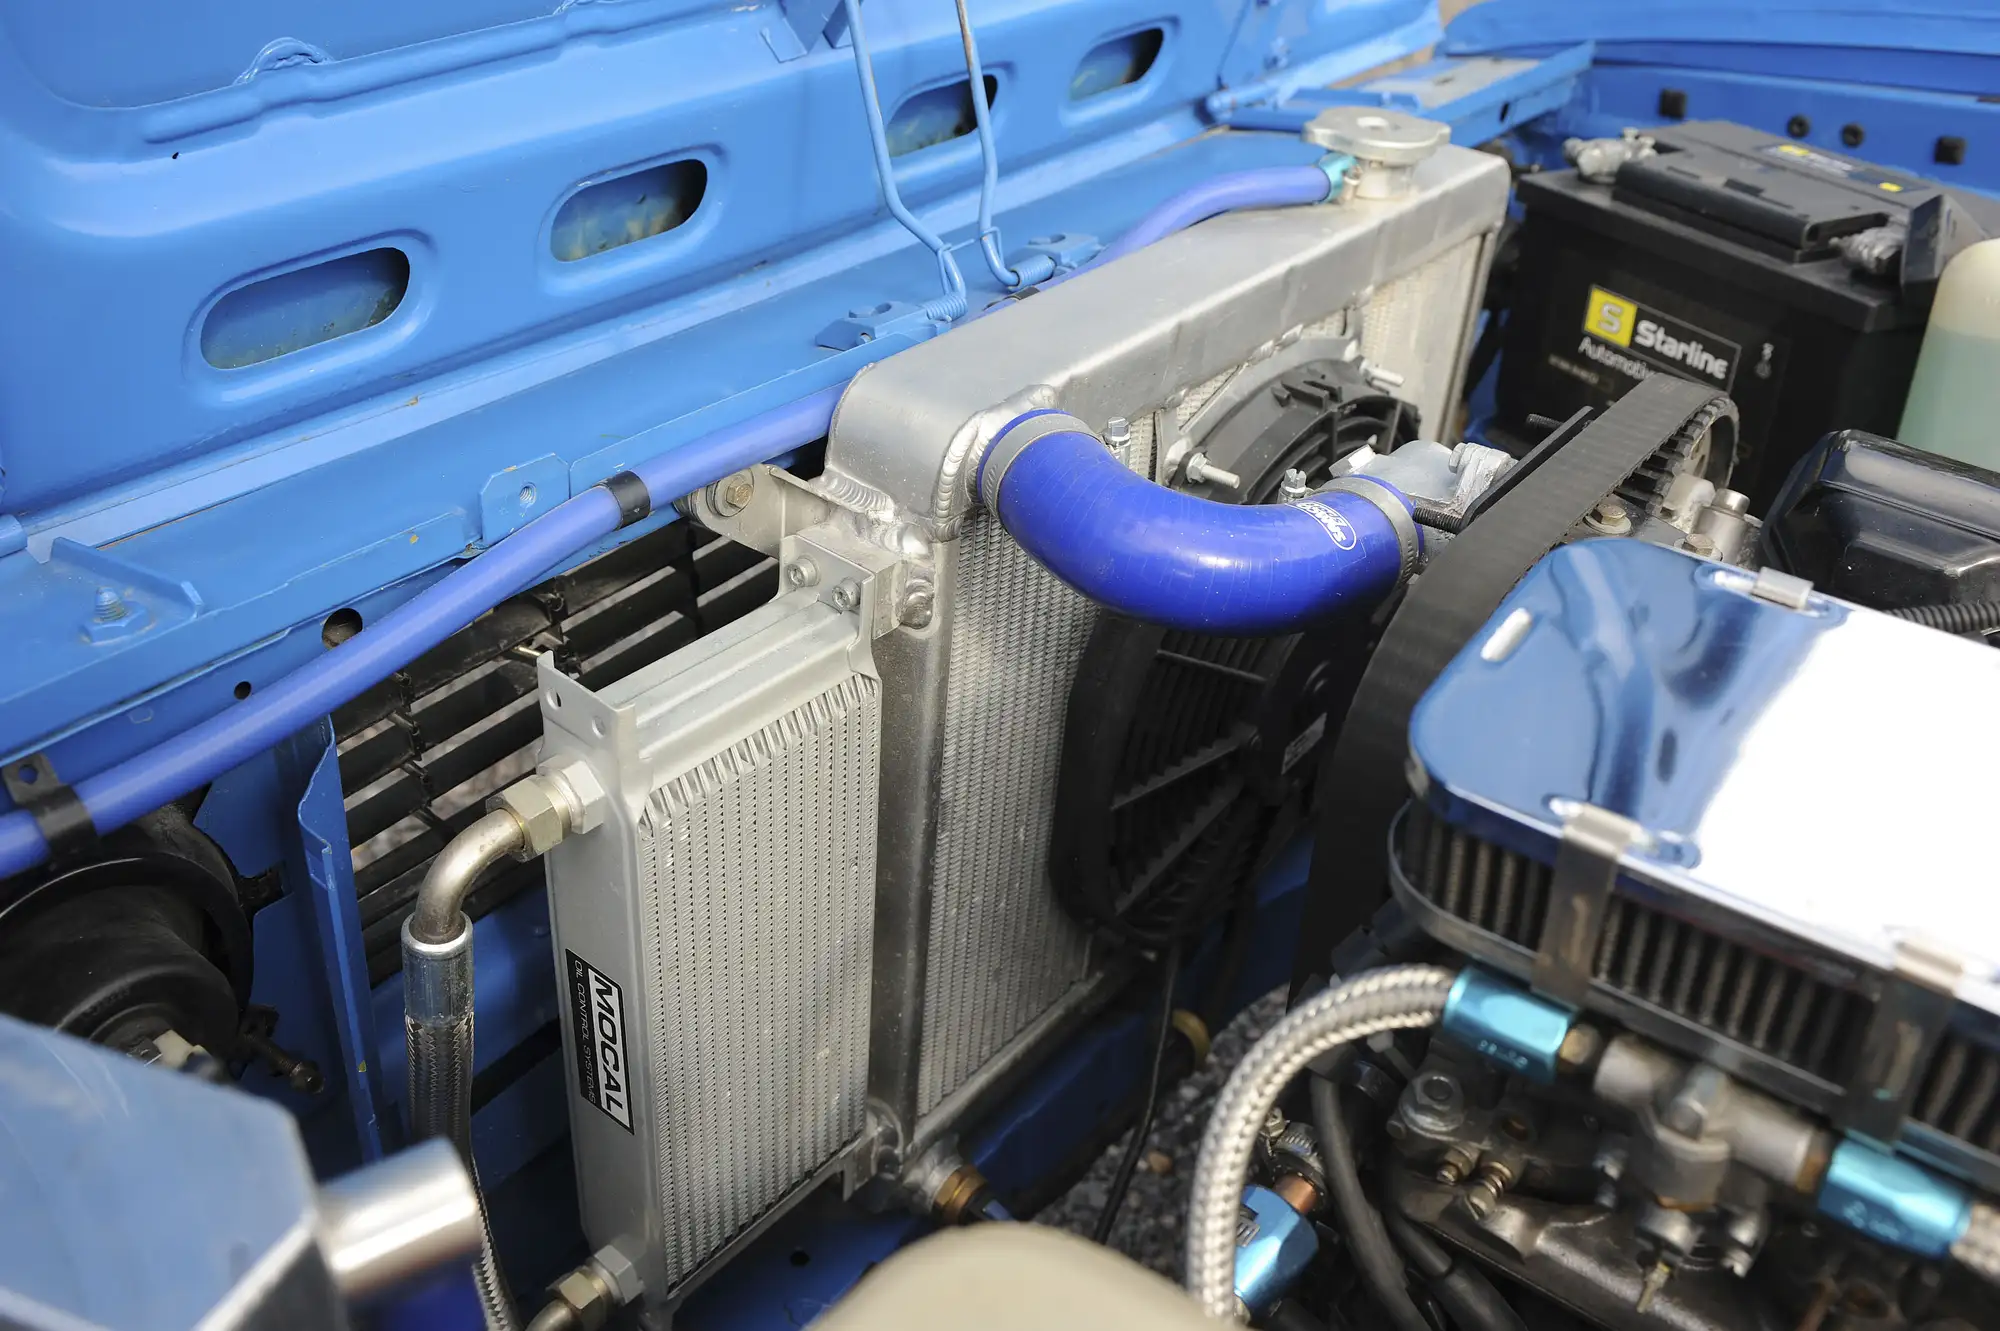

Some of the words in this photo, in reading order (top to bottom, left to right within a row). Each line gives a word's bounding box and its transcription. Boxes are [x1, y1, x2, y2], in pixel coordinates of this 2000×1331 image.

[1578, 336, 1655, 379] Automotiv
[1597, 303, 1624, 334] S
[1634, 319, 1729, 380] Starline
[574, 959, 584, 978] OIL
[576, 983, 590, 1041] CONTROL
[594, 975, 623, 1112] MOCAL
[583, 1045, 597, 1104] SYSTEMS
